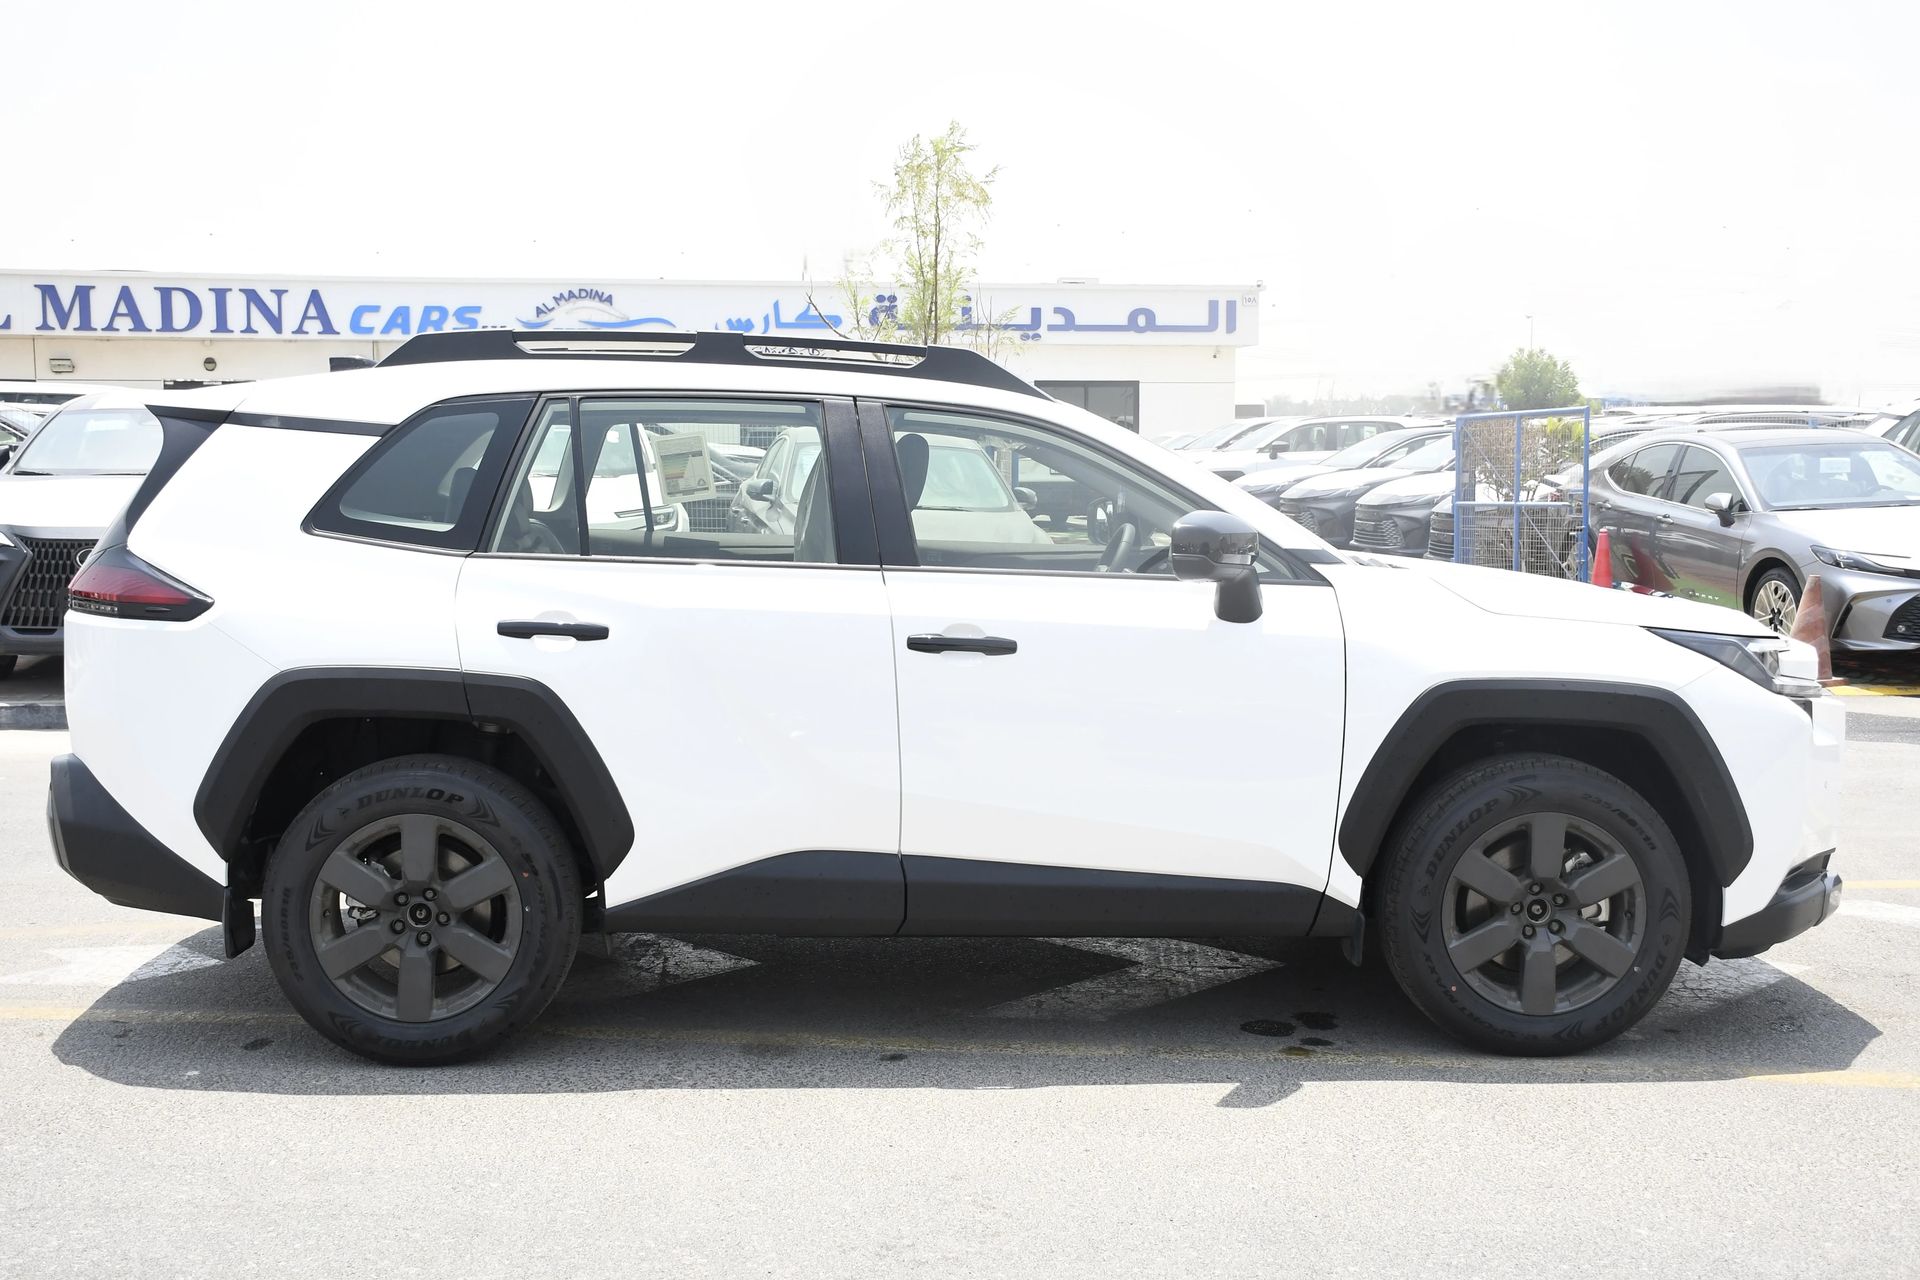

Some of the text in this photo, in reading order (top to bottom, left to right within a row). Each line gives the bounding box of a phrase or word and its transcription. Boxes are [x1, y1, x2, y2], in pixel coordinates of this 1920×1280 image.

[34, 284, 340, 333] MADINA
[349, 305, 482, 334] CARS
[535, 288, 613, 318] AL MADINA
[356, 786, 466, 811] DUNLOP
[1426, 798, 1501, 878] DUNLOP
[1595, 954, 1667, 1033] DUNLOP
